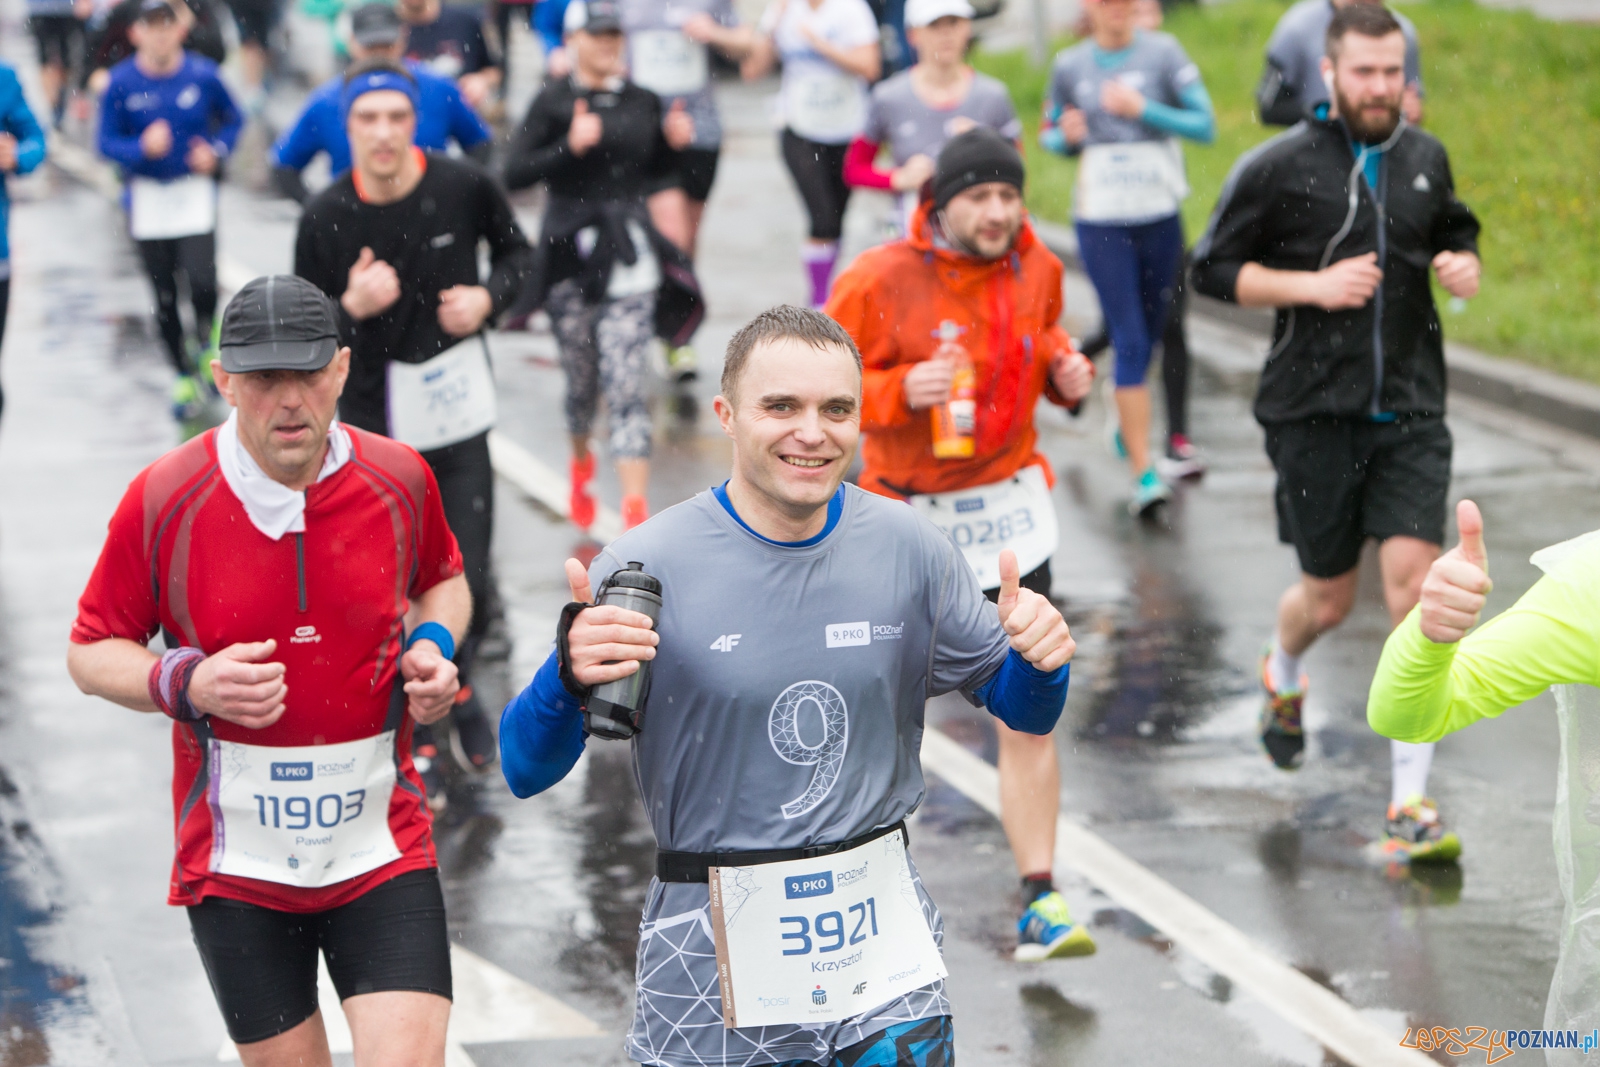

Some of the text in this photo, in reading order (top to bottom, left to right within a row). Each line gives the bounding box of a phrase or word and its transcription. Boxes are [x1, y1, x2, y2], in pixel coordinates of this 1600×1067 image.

[941, 507, 1036, 548] 0283
[709, 633, 742, 652] 4F
[767, 679, 849, 820] 9
[253, 788, 366, 830] 11903
[779, 896, 879, 956] 3921
[811, 949, 863, 973] Krzysztof
